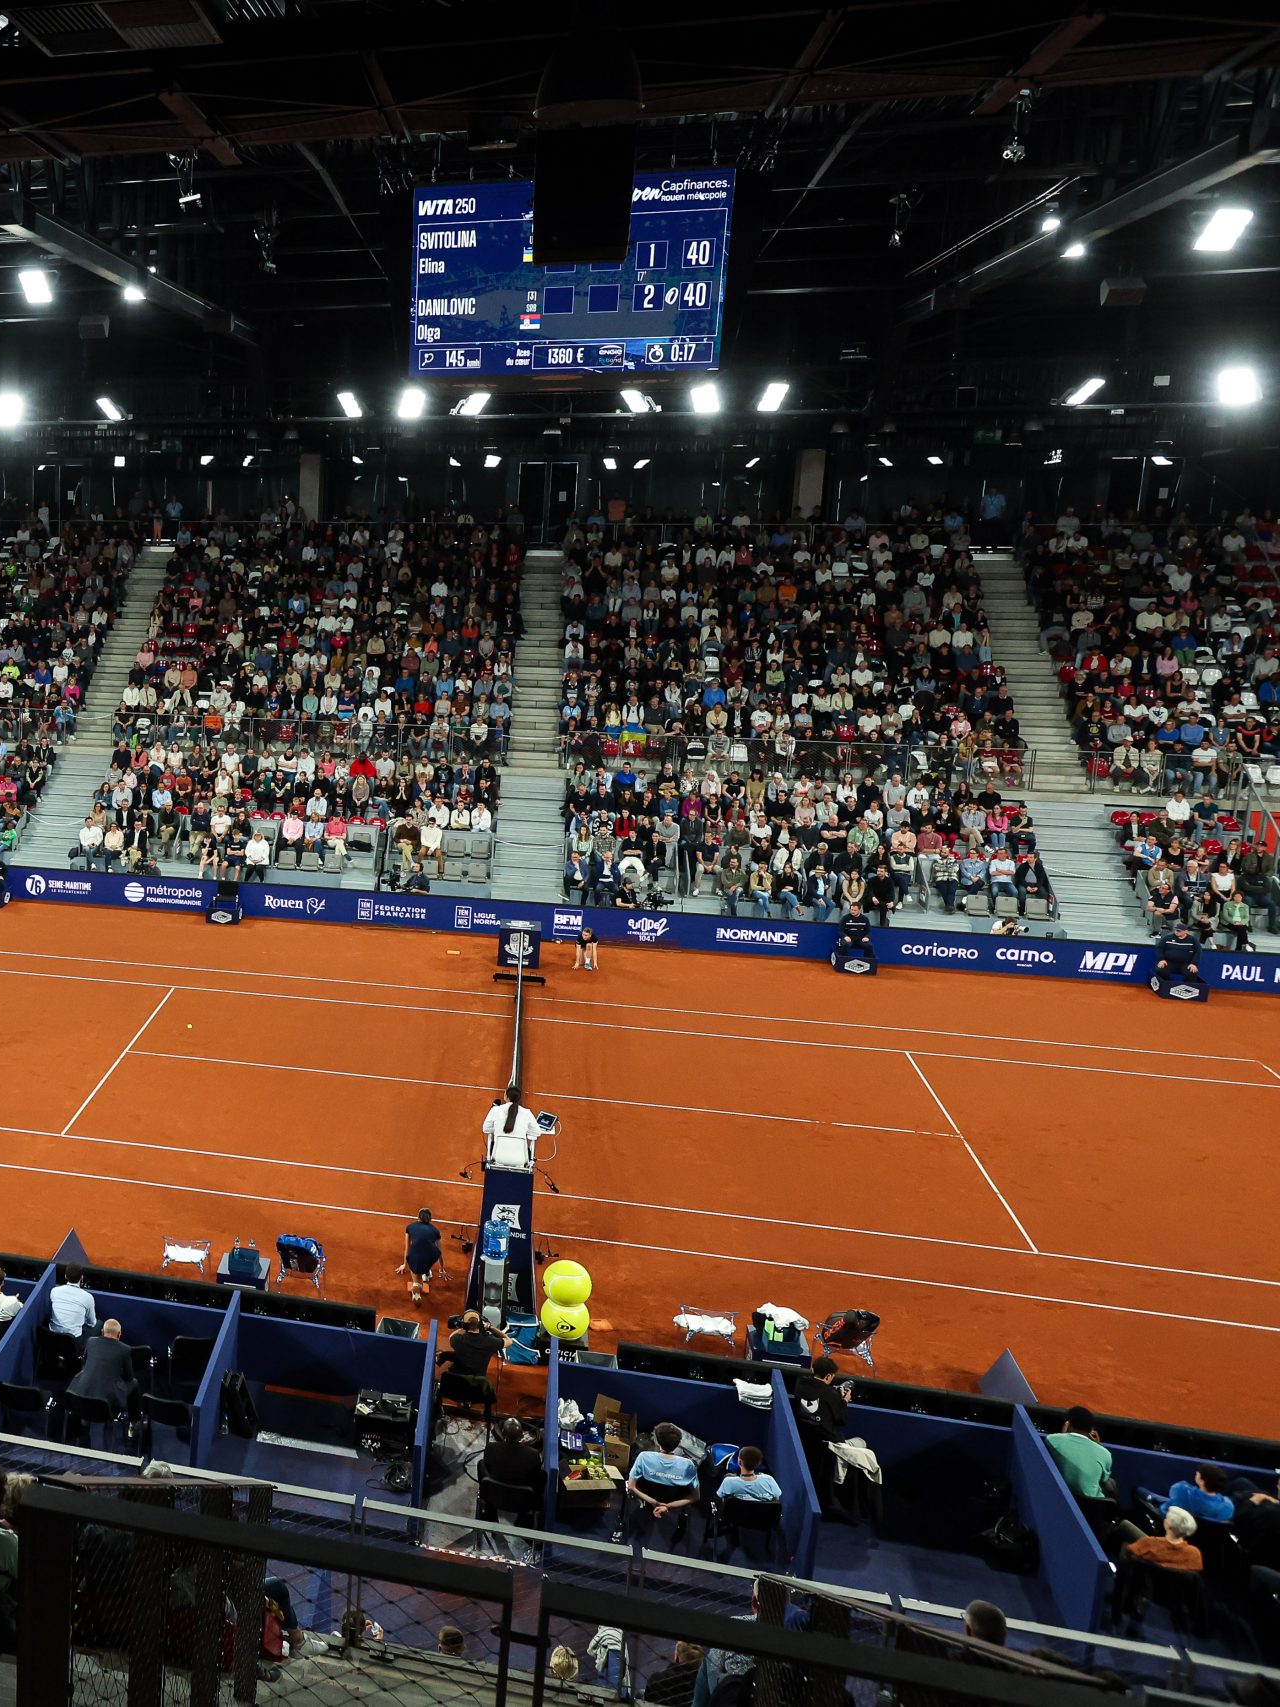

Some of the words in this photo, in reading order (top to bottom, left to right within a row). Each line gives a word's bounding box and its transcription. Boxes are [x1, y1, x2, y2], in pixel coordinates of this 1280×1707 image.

[632, 187, 663, 202] pen
[661, 179, 730, 193] Capfinances.
[418, 199, 454, 216] WTA
[455, 197, 476, 214] 250
[420, 230, 477, 250] SVITOLINA
[649, 243, 656, 267] 1
[686, 240, 710, 265] 40
[419, 257, 445, 275] Elina
[643, 285, 655, 309] 2
[683, 282, 707, 307] 40
[418, 297, 476, 317] DANILOVIC
[417, 324, 441, 343] Olga
[446, 350, 465, 367] 145
[548, 348, 573, 364] 1360
[577, 347, 585, 363] €
[670, 343, 696, 362] 0:17
[29, 877, 41, 894] 76
[48, 879, 92, 891] SEINE-MARITIME
[146, 884, 202, 898] métropole
[264, 894, 303, 909] Rouen
[473, 918, 501, 926] NORMA
[554, 914, 582, 925] BFM
[720, 928, 799, 944] NORMANDIE
[996, 948, 1057, 963] carno.
[1079, 950, 1138, 973] MPI
[1221, 964, 1265, 982] PAUL
